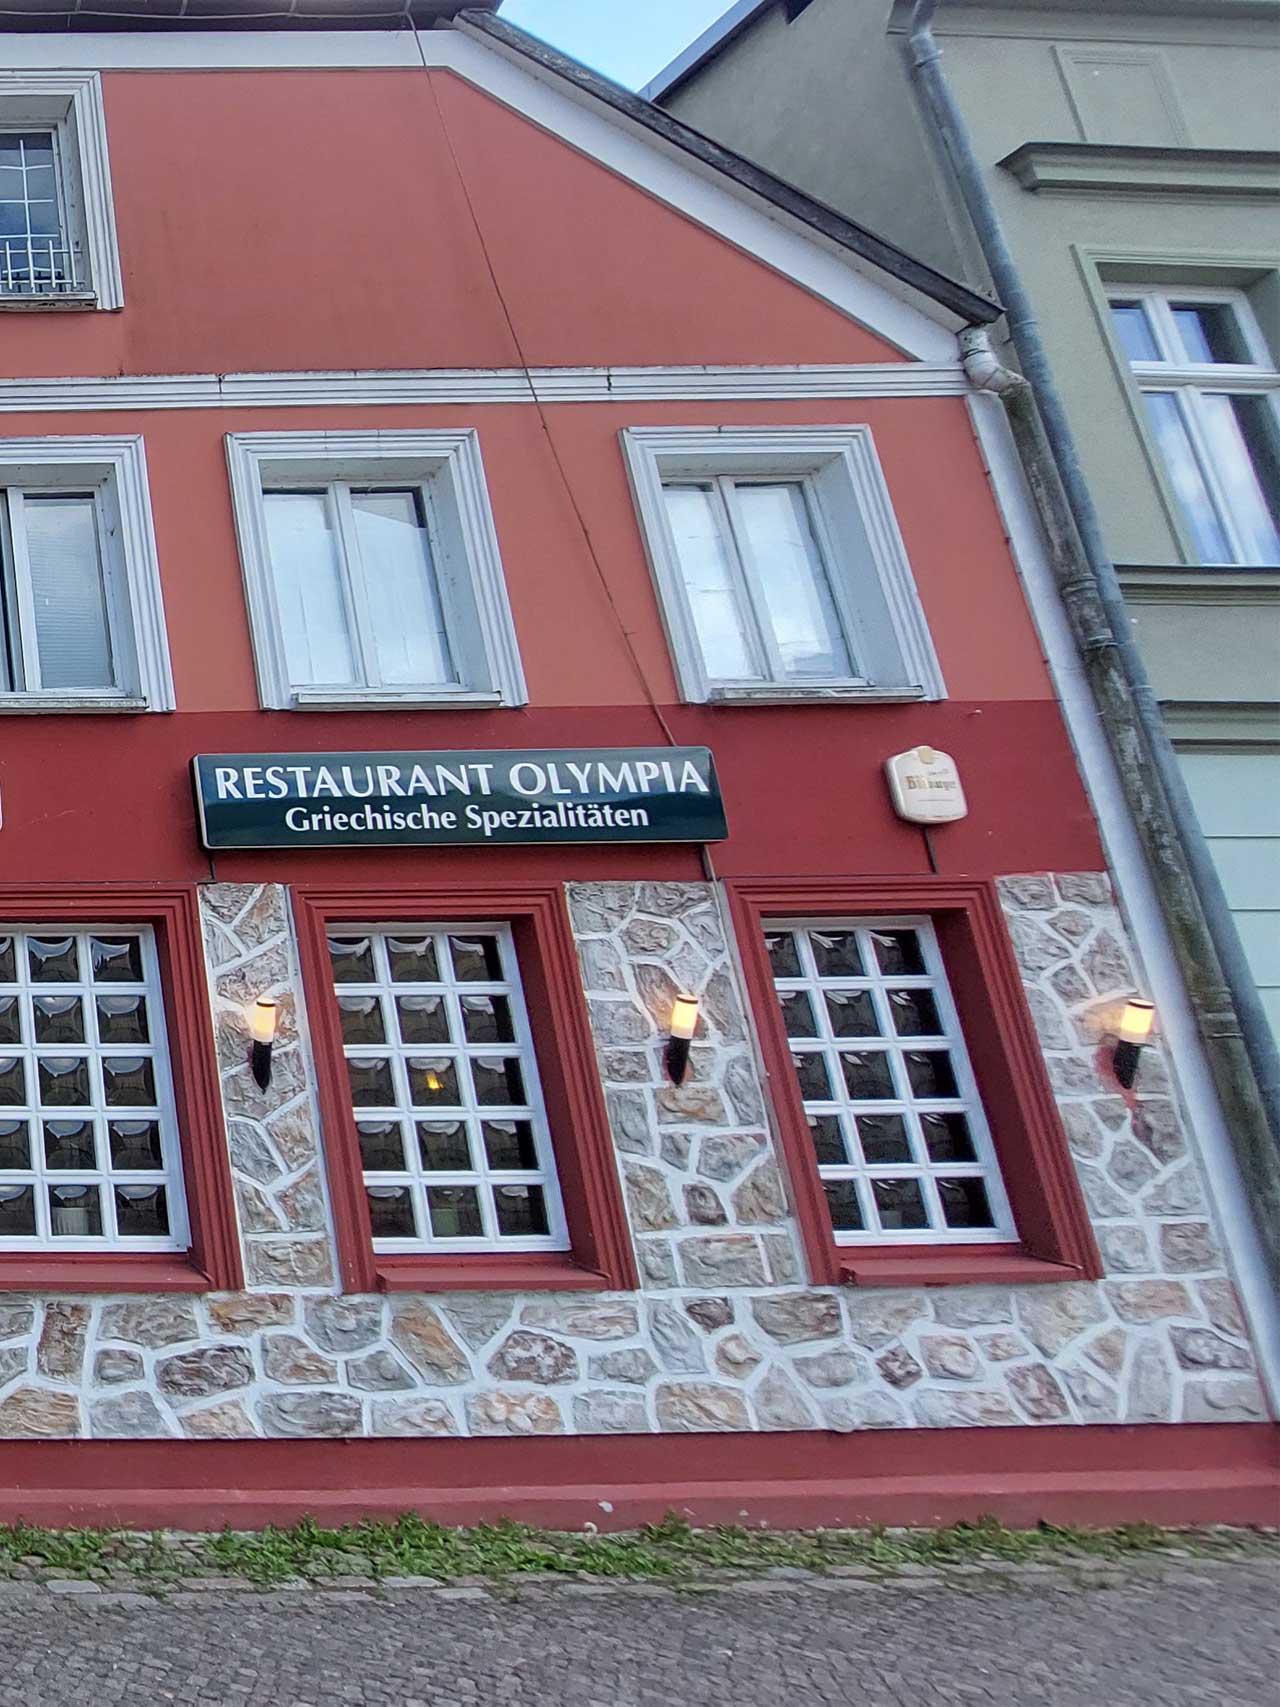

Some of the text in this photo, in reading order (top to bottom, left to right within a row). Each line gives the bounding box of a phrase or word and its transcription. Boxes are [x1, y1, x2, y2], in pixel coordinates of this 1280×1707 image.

[214, 760, 710, 800] RESTAURANT OLYMPIA
[284, 801, 650, 837] Griechische Spezialitäten
